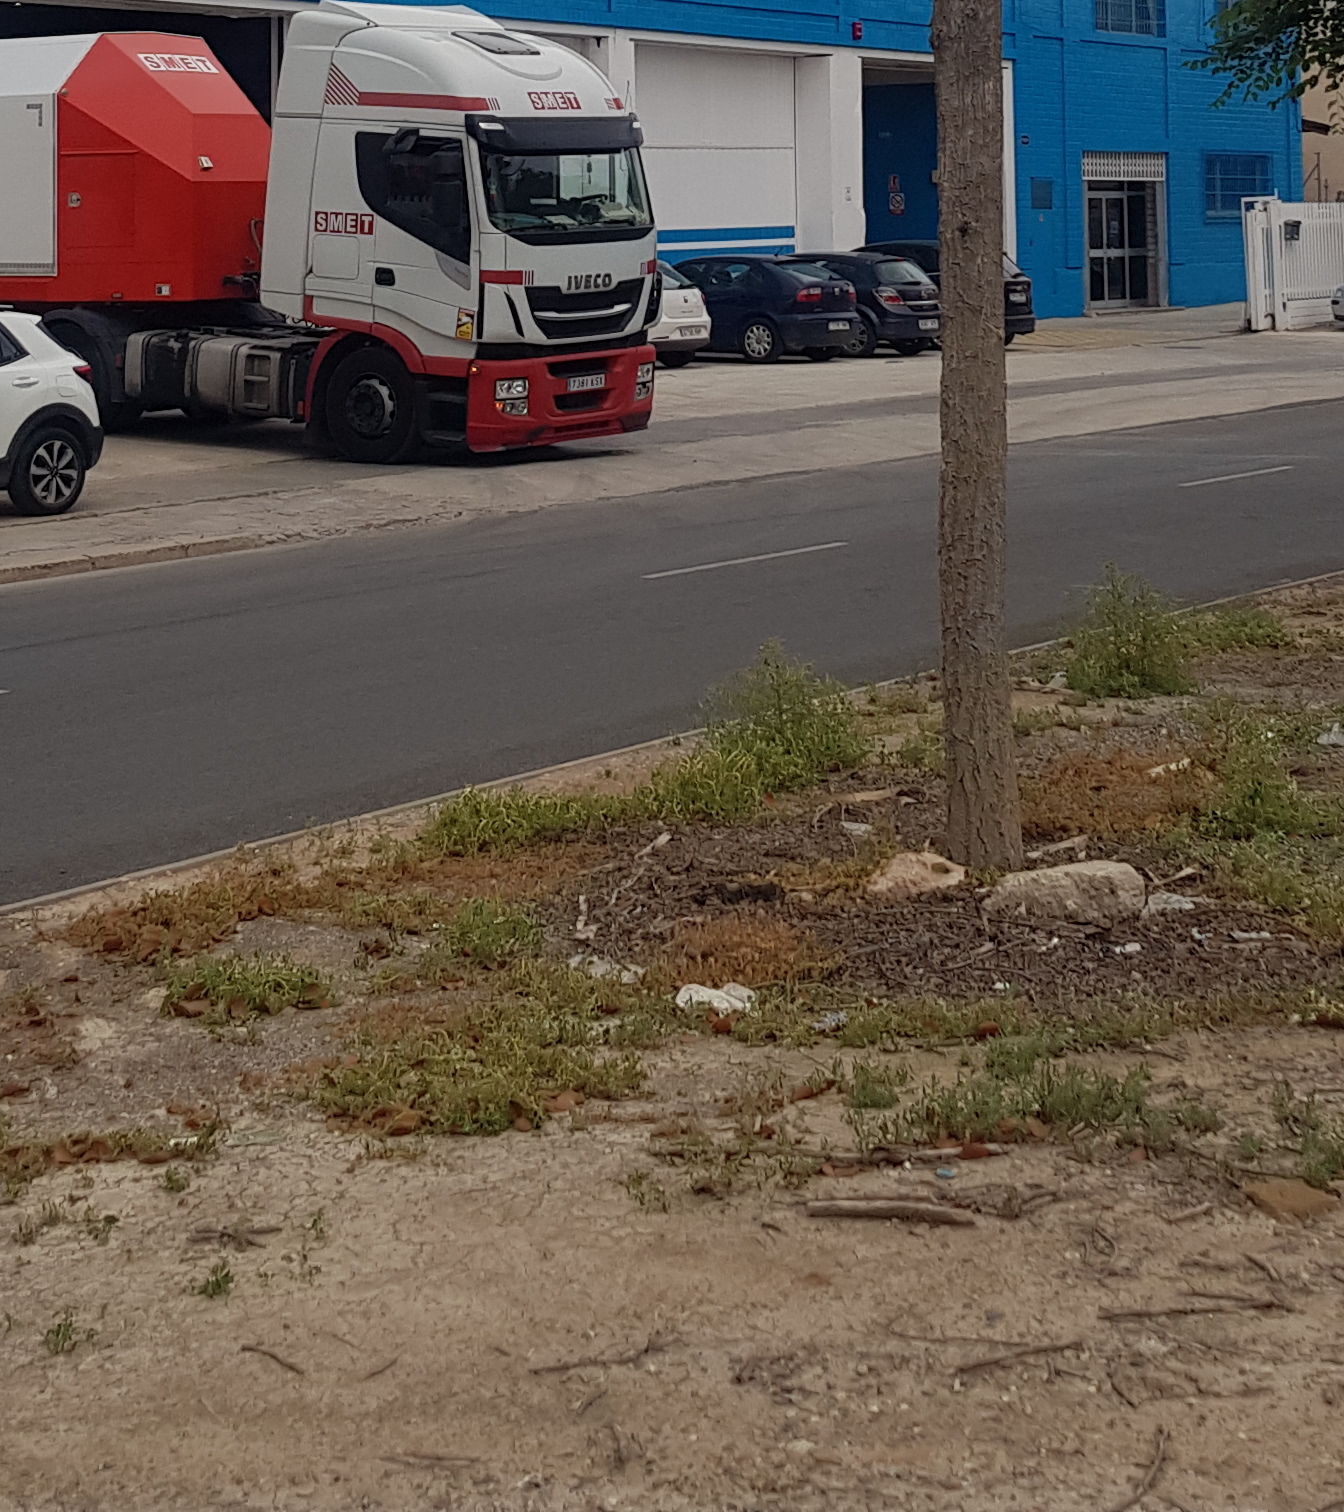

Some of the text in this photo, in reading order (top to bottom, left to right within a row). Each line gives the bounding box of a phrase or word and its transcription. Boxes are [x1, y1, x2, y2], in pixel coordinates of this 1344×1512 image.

[141, 55, 214, 72] SMET
[528, 92, 580, 109] SMET
[316, 212, 374, 234] SMET
[567, 273, 612, 290] IVECO
